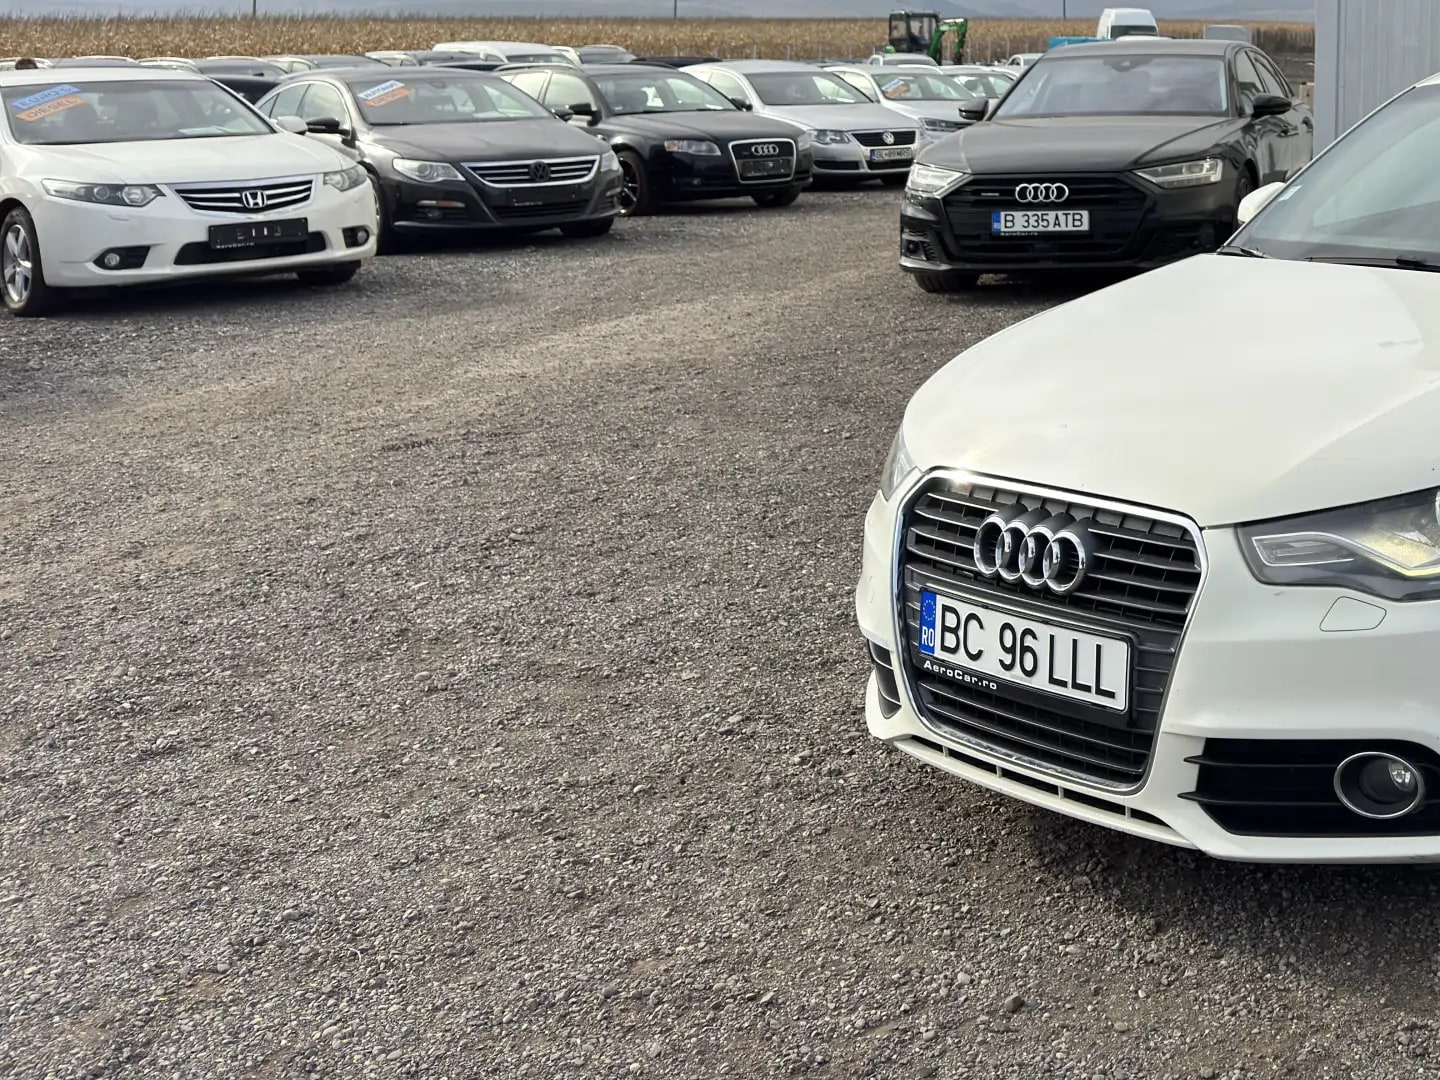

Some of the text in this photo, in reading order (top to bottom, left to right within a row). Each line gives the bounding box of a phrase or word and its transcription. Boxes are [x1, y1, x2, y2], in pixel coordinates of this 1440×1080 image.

[27, 98, 77, 119] DIESEL
[1004, 213, 1015, 229] B
[1021, 213, 1050, 229] 335
[1052, 212, 1083, 228] ATB
[921, 625, 935, 647] RO
[940, 603, 1116, 700] BC 96 LLL
[923, 659, 998, 691] AeroCar.ro
